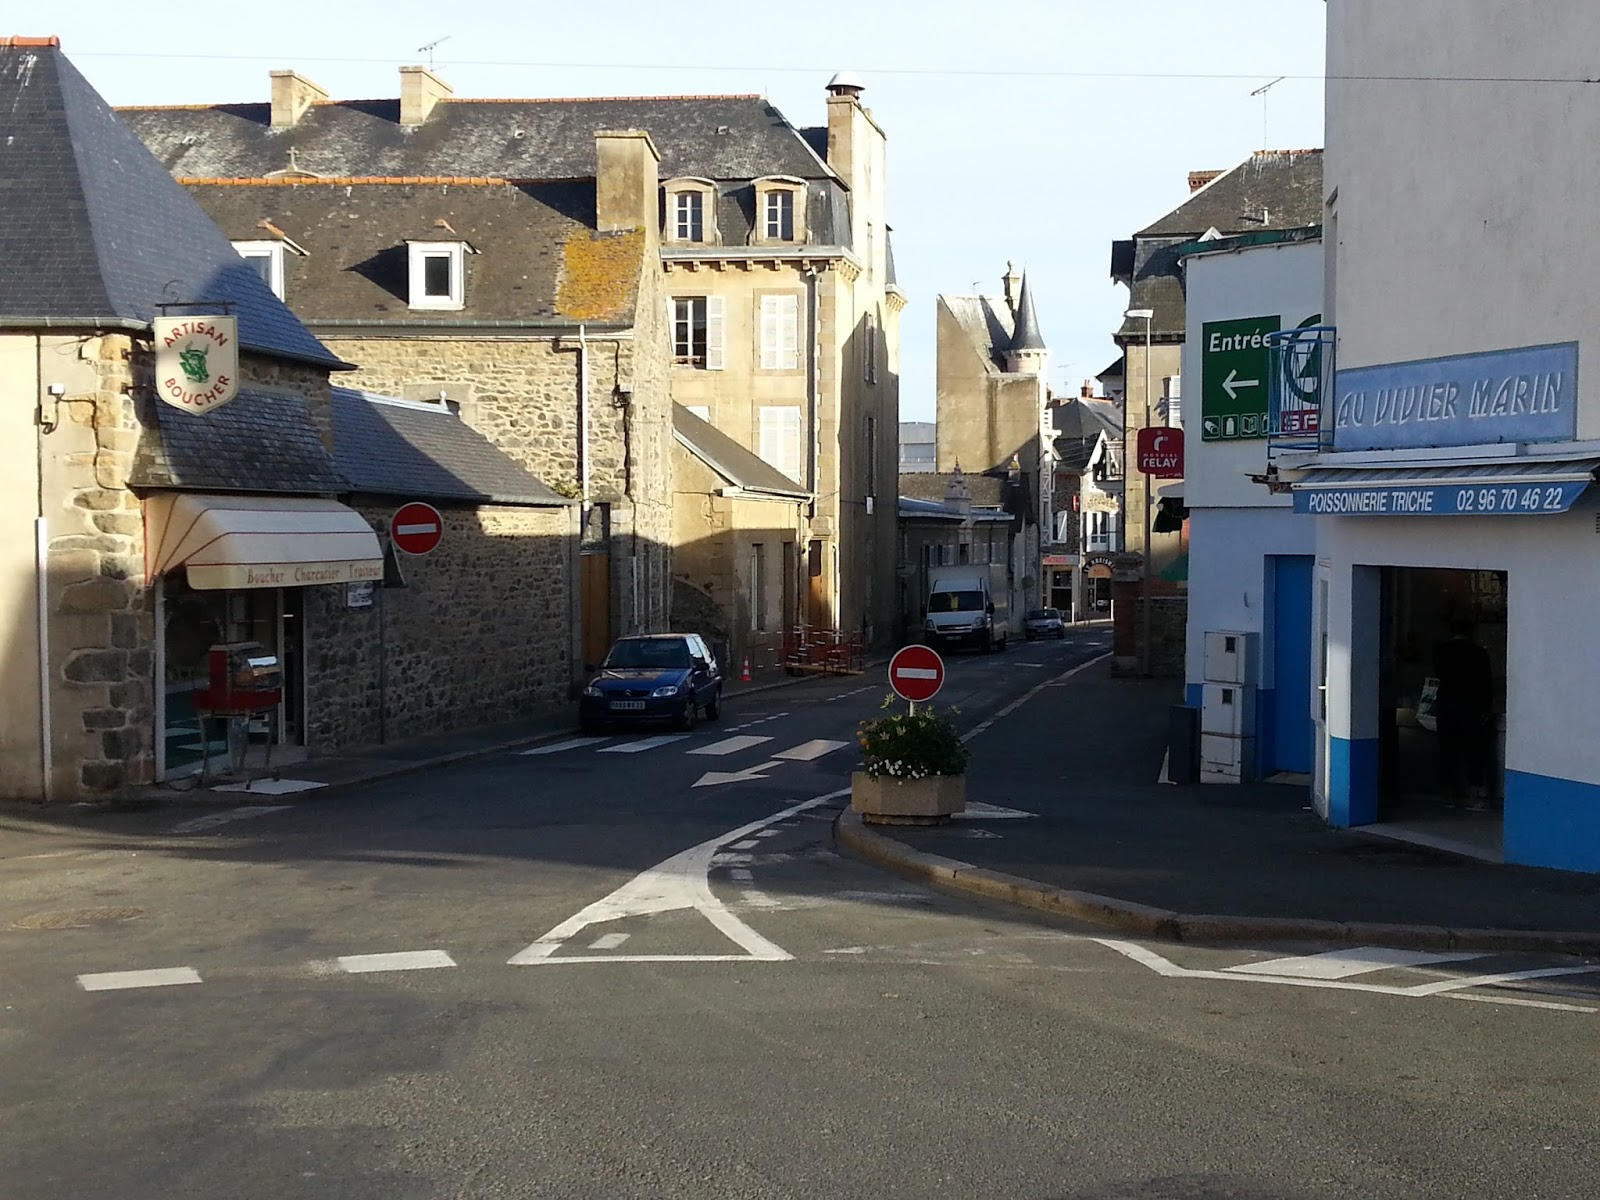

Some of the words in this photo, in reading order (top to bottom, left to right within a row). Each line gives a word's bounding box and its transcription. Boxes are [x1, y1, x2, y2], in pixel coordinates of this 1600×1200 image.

[163, 322, 229, 348] ARTISAN
[1209, 328, 1271, 353] Entrée
[164, 375, 231, 406] BOUCHER
[1335, 391, 1365, 429] AU
[1373, 380, 1460, 427] VIVIER
[1468, 371, 1564, 419] MARIN
[1308, 491, 1387, 512] POISSONNERIE
[1391, 491, 1434, 512] TRICHE
[1456, 490, 1474, 511] 02
[1478, 489, 1497, 511] 96
[1500, 489, 1517, 510] 70
[1520, 488, 1540, 510] 46
[1543, 487, 1563, 509] 22
[247, 568, 285, 585] Boucher
